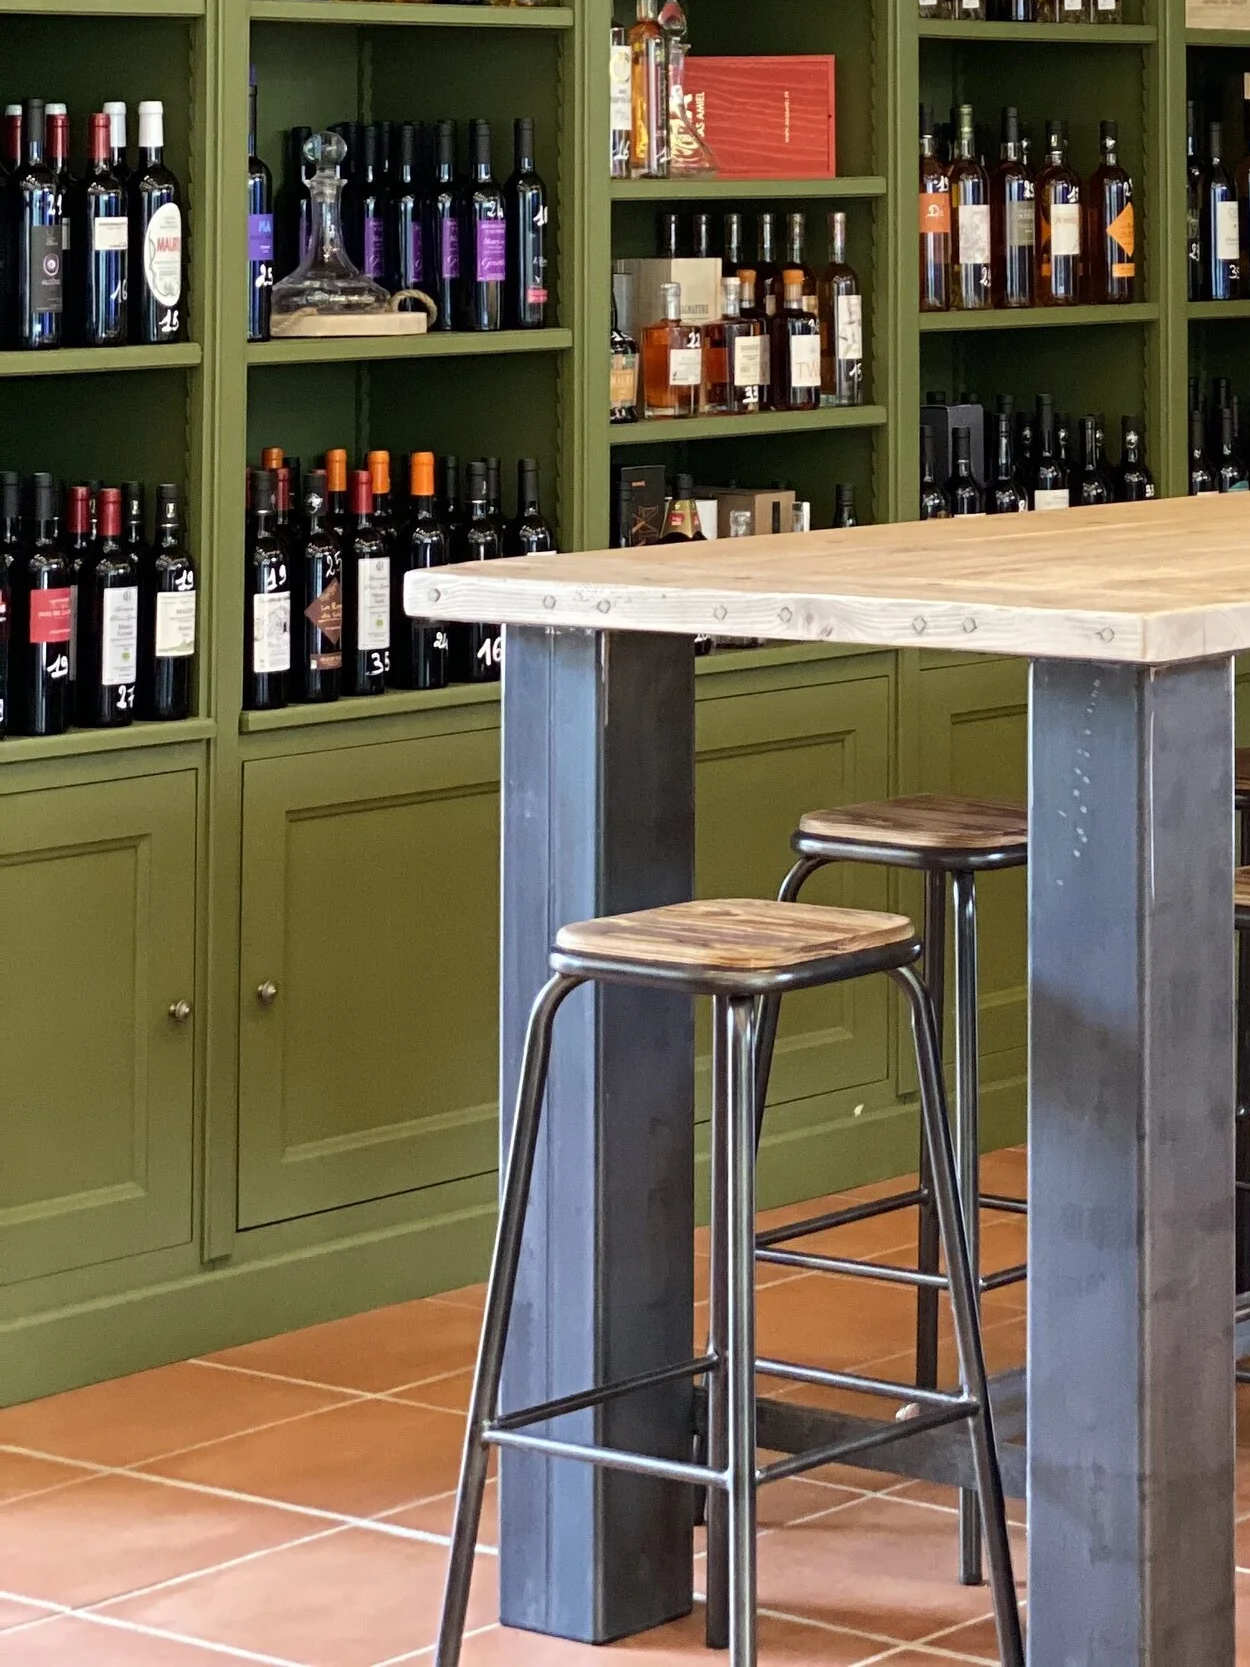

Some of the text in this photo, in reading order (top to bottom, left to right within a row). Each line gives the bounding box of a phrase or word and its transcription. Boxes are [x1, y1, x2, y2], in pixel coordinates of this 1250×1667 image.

[170, 569, 194, 591] 19
[266, 565, 287, 591] 19
[476, 636, 502, 667] 16
[46, 653, 69, 680] 19
